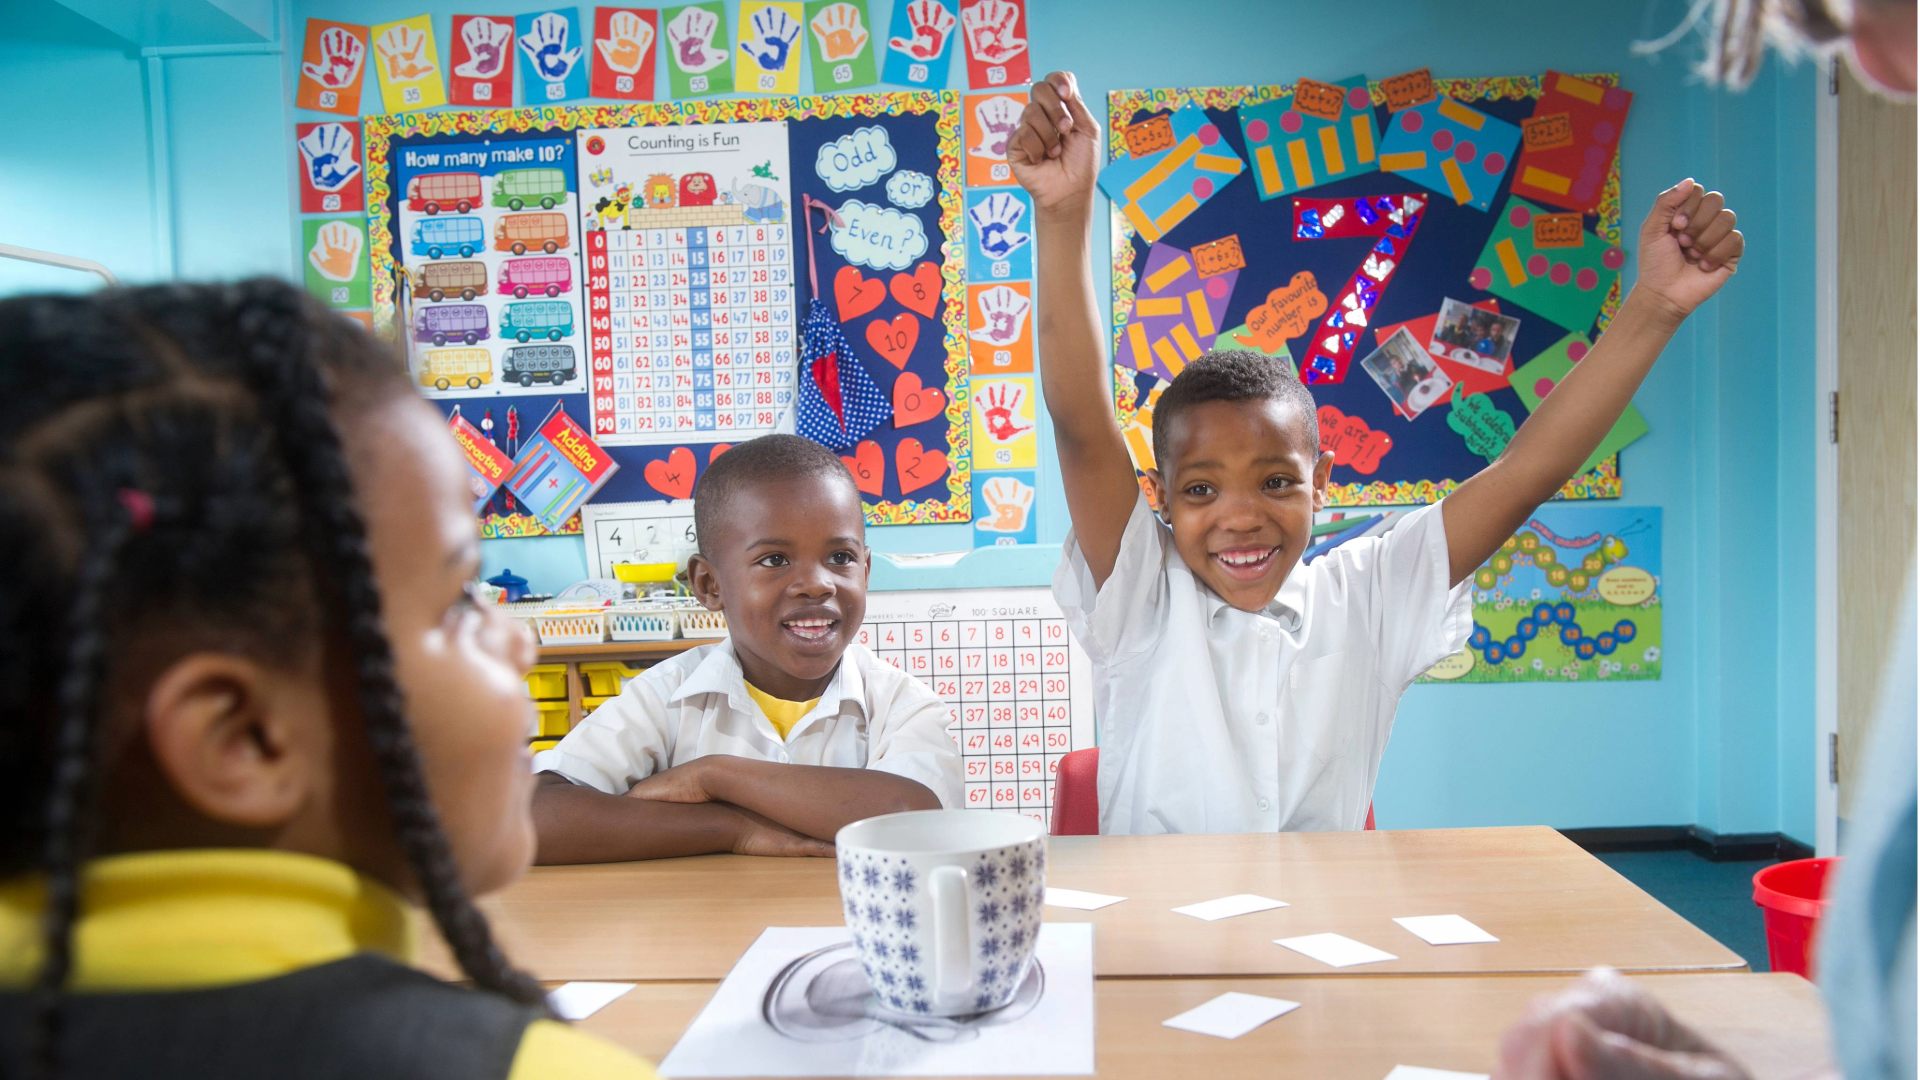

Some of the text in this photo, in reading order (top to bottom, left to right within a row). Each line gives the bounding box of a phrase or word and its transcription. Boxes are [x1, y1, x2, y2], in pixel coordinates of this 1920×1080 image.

[835, 67, 850, 80] 65
[911, 67, 925, 79] 70
[990, 69, 1004, 80] 75
[616, 76, 633, 92] 50
[692, 78, 706, 91] 55
[761, 76, 775, 89] 60
[406, 89, 419, 101] 35
[476, 86, 489, 97] 40
[550, 85, 563, 97] 45
[321, 93, 336, 106] 30
[628, 132, 740, 150] Counting is Fun
[406, 144, 564, 169] How many make 10?
[833, 141, 877, 172] Odd
[993, 166, 1008, 178] 80
[900, 181, 923, 195] or
[325, 196, 339, 208] 25
[595, 228, 784, 248] 0 1 2 3 4 5 6 7 8 9
[592, 249, 785, 269] 10 11 12 13 14 15 16 17 18 19
[994, 264, 1008, 276] 85
[592, 269, 787, 289] 20 21 22 23 24 25 26 27 28 29
[334, 289, 348, 301] 20
[848, 286, 863, 303] 7
[912, 283, 926, 301] 8
[1292, 193, 1428, 386] 7
[1250, 277, 1316, 331] Our favourite
[1266, 296, 1317, 337] number is
[1289, 316, 1307, 334] 7!
[885, 330, 908, 352] 10
[996, 352, 1009, 364] 90
[904, 393, 920, 411] 0
[1321, 412, 1369, 443] We are
[452, 427, 503, 478] Subtracting
[556, 427, 598, 472] Adding
[996, 451, 1010, 462] 95
[1321, 433, 1376, 465] all 7!
[857, 462, 870, 479] 6
[905, 457, 921, 478] 2
[664, 471, 680, 485] 4
[609, 524, 696, 546] 4 2 6
[1522, 538, 1536, 550] 12
[1585, 559, 1601, 570] 20
[992, 606, 1038, 616] SQUARE
[1557, 608, 1570, 619] 11
[860, 625, 1061, 644] 3 4 5 6 7 8 9 10
[1524, 624, 1532, 634] 7
[1600, 637, 1612, 648] 17
[912, 656, 926, 669] 15
[939, 656, 953, 668] 16
[967, 655, 981, 667] 17
[993, 654, 1007, 667] 18
[1020, 653, 1034, 666] 19
[1046, 653, 1064, 665] 20
[938, 680, 1065, 695] 26 27 28 29 30
[967, 709, 984, 722] 37
[994, 708, 1011, 721] 38
[1020, 708, 1038, 720] 39
[1048, 707, 1066, 719] 40
[968, 736, 985, 748] 47
[994, 735, 1012, 747] 48
[1022, 734, 1039, 747] 49
[1048, 734, 1066, 746] 50
[968, 760, 1058, 775] 57 58 59 6
[970, 789, 987, 802] 67
[996, 789, 1014, 801] 68
[1023, 788, 1040, 800] 69
